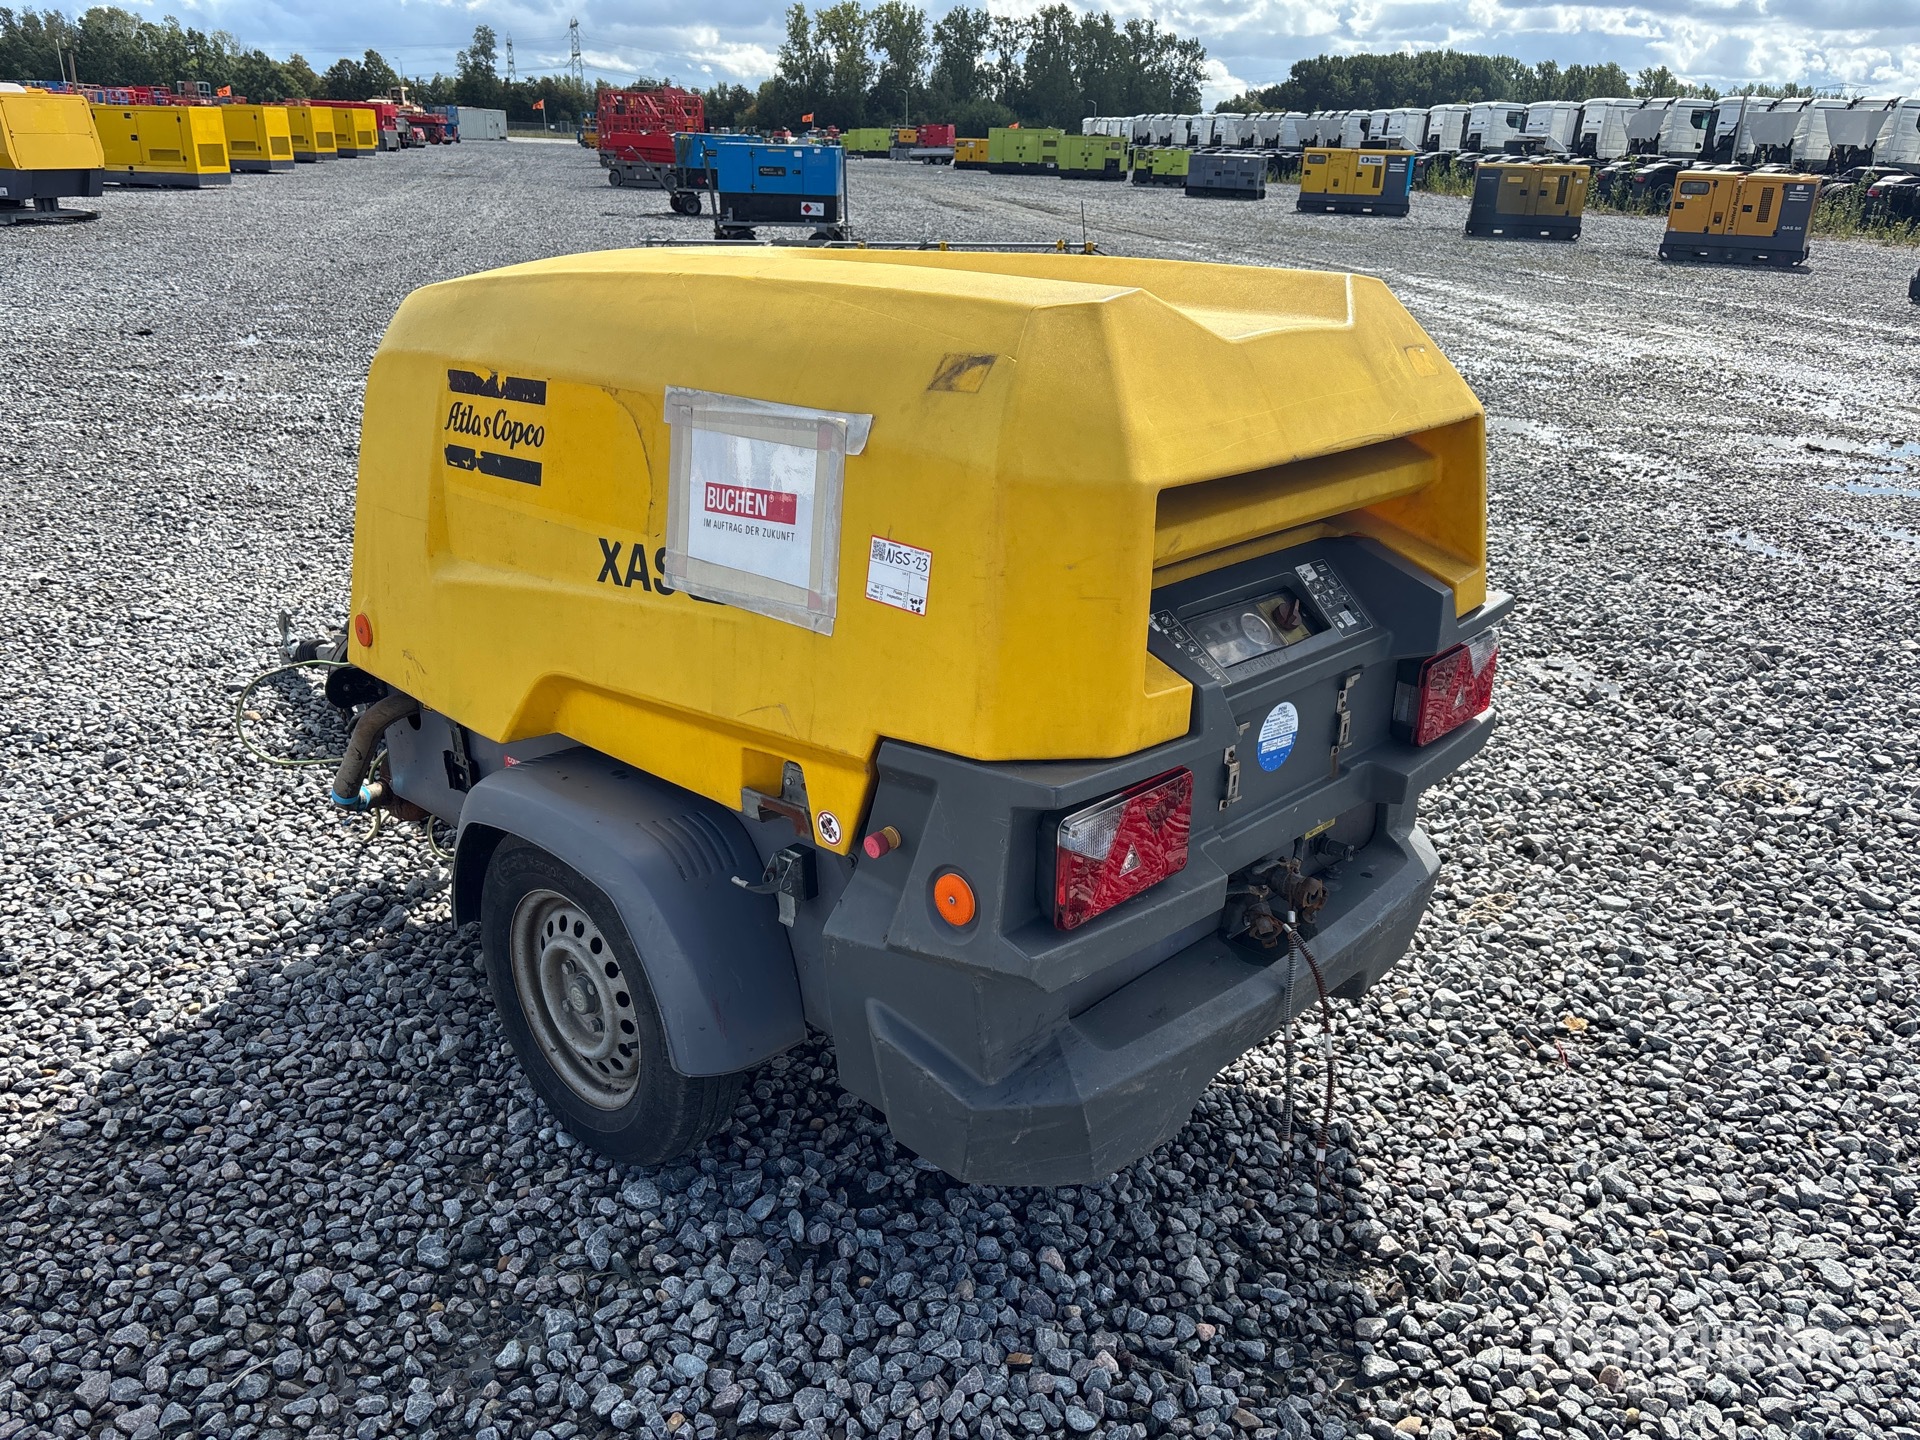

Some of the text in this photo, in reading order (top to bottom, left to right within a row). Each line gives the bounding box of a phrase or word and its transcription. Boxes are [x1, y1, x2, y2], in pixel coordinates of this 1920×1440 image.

[444, 402, 545, 450] Atlas Copco
[706, 486, 768, 517] BUCHEN
[703, 518, 795, 542] IM AUFTRAG DER ZUKUNFT
